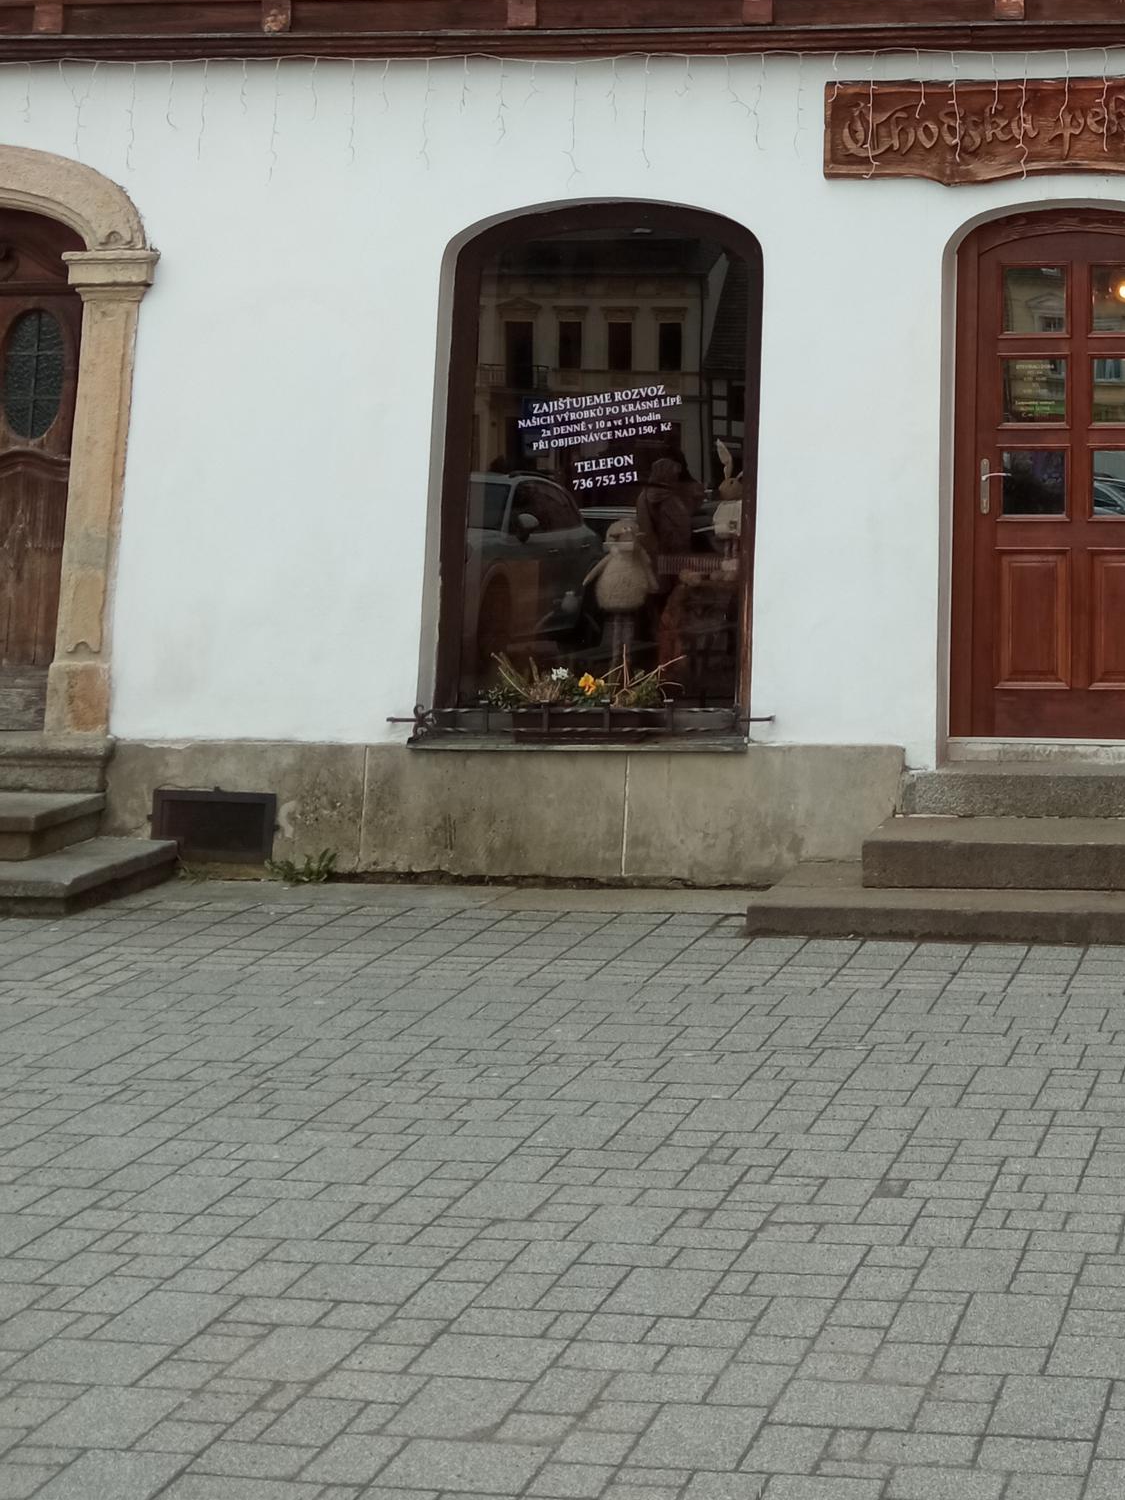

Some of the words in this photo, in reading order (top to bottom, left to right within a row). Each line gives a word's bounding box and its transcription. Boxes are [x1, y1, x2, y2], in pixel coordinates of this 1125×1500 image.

[532, 392, 612, 415] ZAJIŠŤUJEME
[614, 384, 666, 402] ROZVOZ
[517, 411, 555, 429] NAŠICH
[556, 406, 604, 424] VÝROBKŮ
[605, 406, 620, 416] PO
[621, 398, 660, 414] KRÁSNÉ
[552, 421, 586, 437] DENNĚ
[595, 420, 605, 430] 10
[624, 416, 635, 425] 14
[635, 411, 662, 424] hodin
[532, 440, 549, 451] PŘI
[550, 430, 614, 449] OBJEDNÁVCE
[614, 427, 637, 440] NAD
[574, 454, 634, 474] TELEFON
[572, 478, 594, 491] 736
[595, 474, 617, 487] 752
[618, 470, 639, 485] 551
